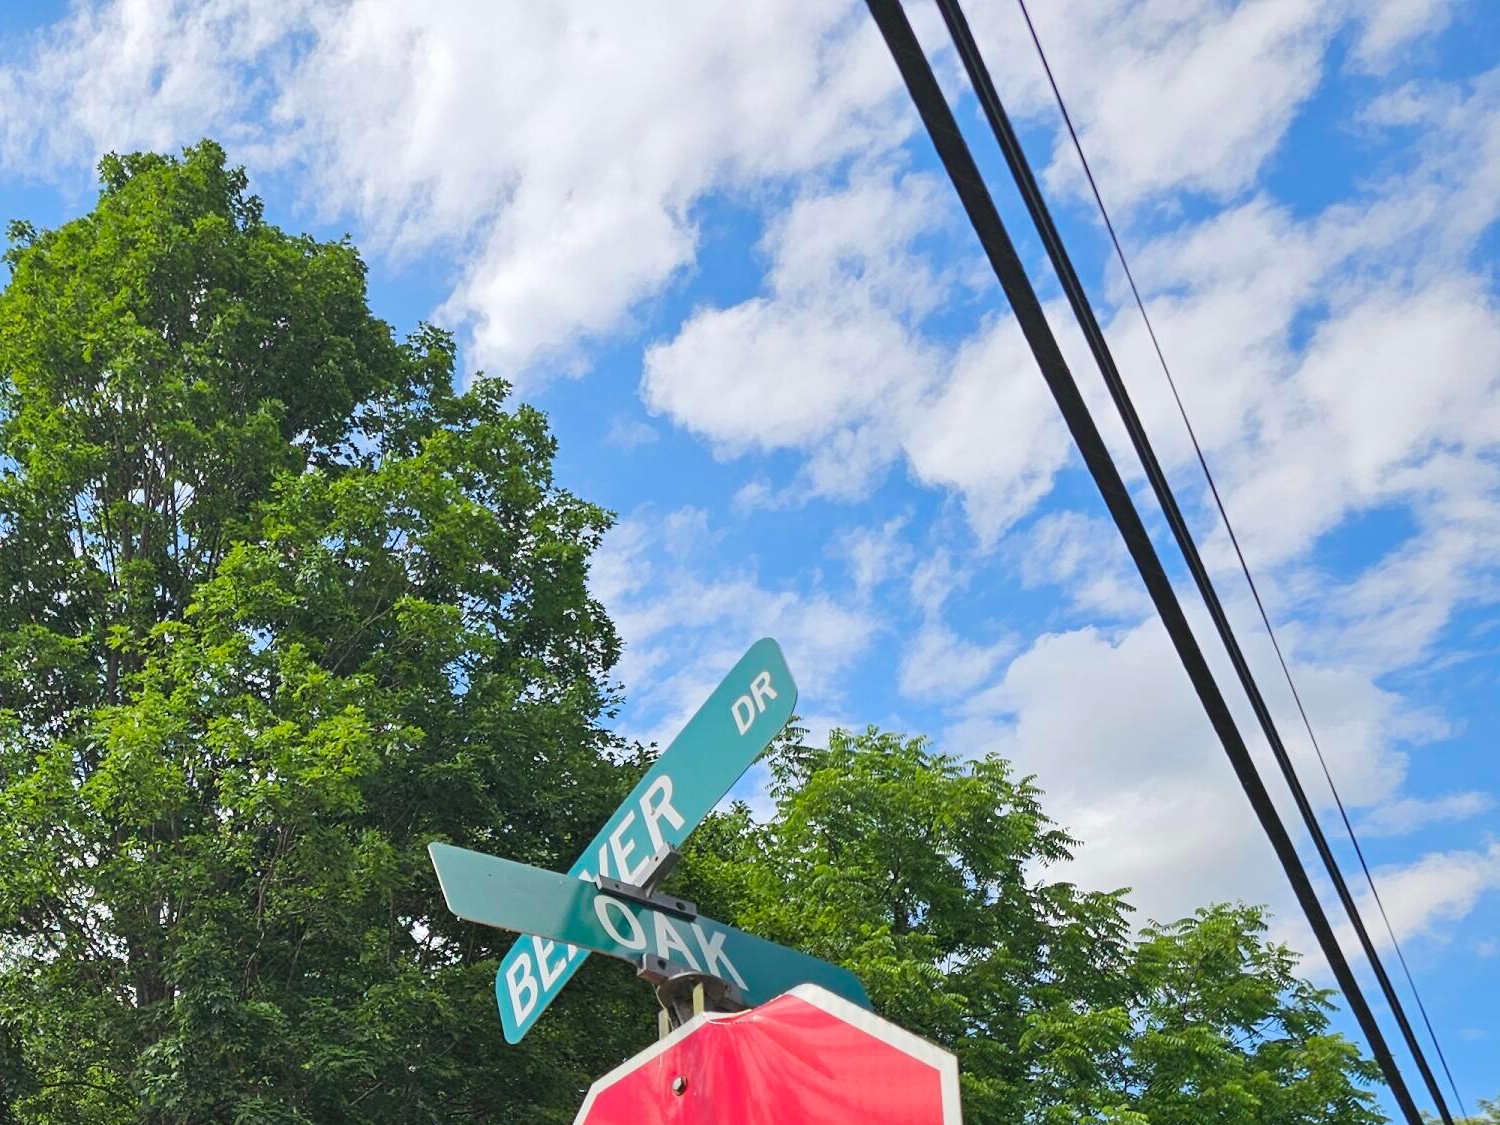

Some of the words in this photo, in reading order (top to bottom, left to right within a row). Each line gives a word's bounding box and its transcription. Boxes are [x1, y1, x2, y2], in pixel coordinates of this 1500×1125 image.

[506, 774, 684, 1028] BEER
[730, 670, 779, 737] DR
[594, 894, 749, 992] OAK
